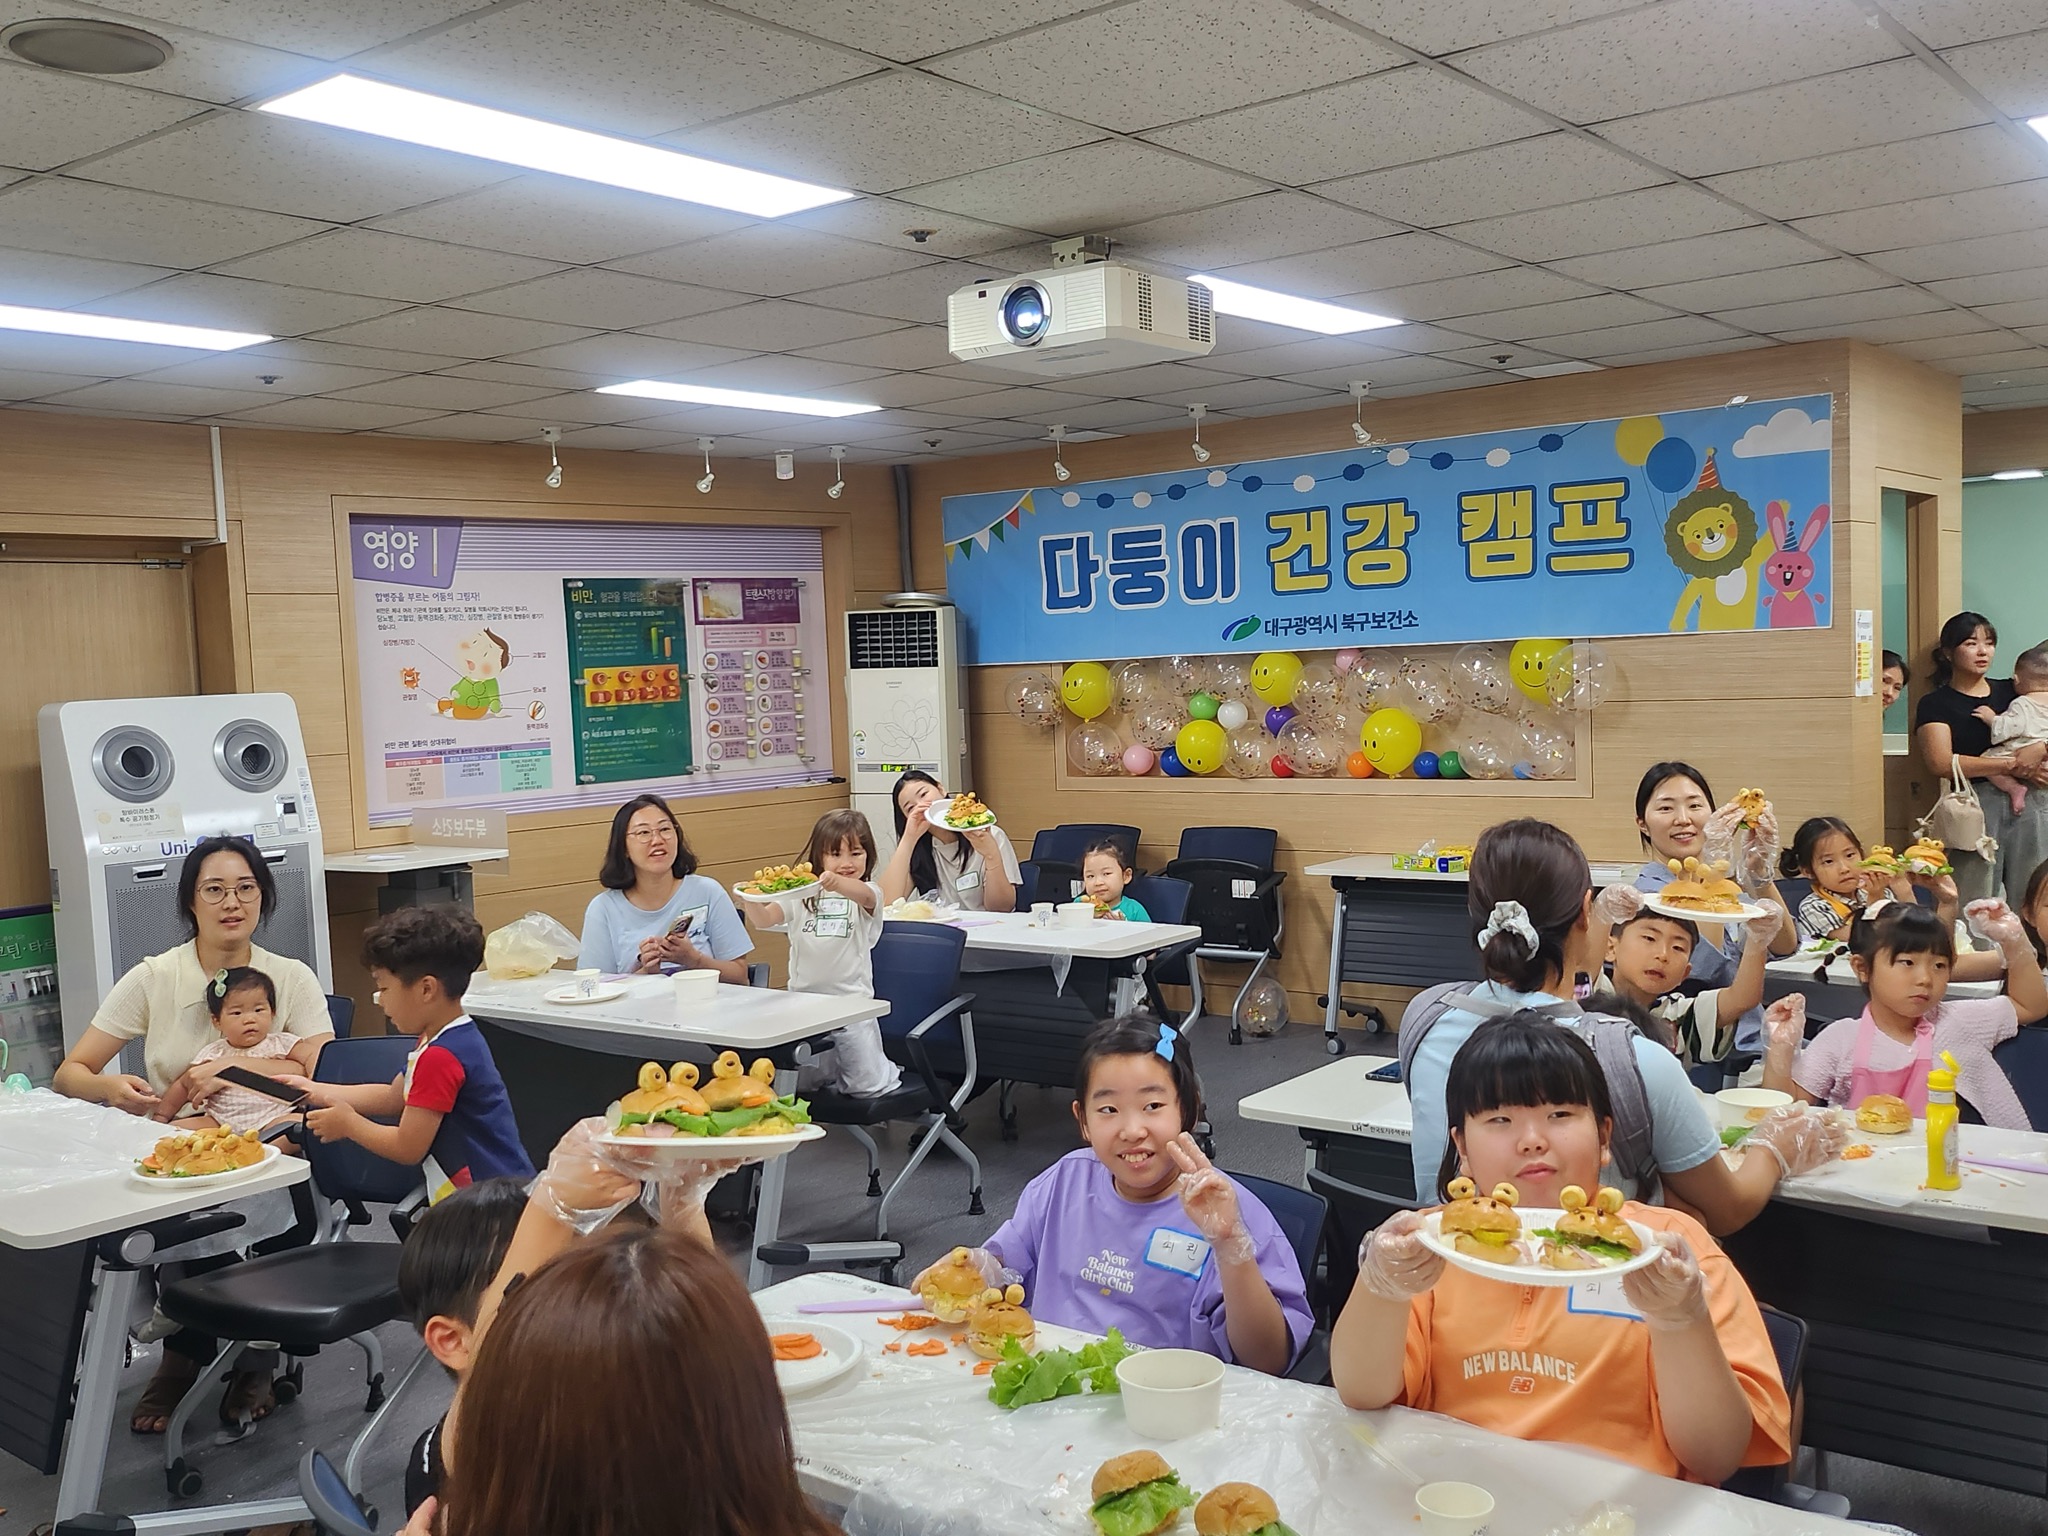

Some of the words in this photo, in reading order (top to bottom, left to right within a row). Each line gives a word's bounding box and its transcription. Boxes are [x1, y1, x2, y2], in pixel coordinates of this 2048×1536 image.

[363, 530, 420, 570] 영양
[1039, 516, 1240, 615] 다둥이
[1266, 497, 1420, 596] 건강
[1457, 476, 1633, 583] 캠프
[375, 592, 405, 602] 합병증을
[408, 592, 429, 602] 부르는
[456, 592, 481, 602] 그림자!
[1264, 613, 1338, 637] 대구광역시
[1341, 610, 1420, 633] 북구보건소
[1087, 1256, 1135, 1280] Balance
[1102, 1249, 1129, 1267] New
[1080, 1267, 1107, 1286] Girls
[1107, 1276, 1134, 1295] Club
[1463, 1352, 1496, 1380] NEW
[1498, 1350, 1576, 1385] BALANCE
